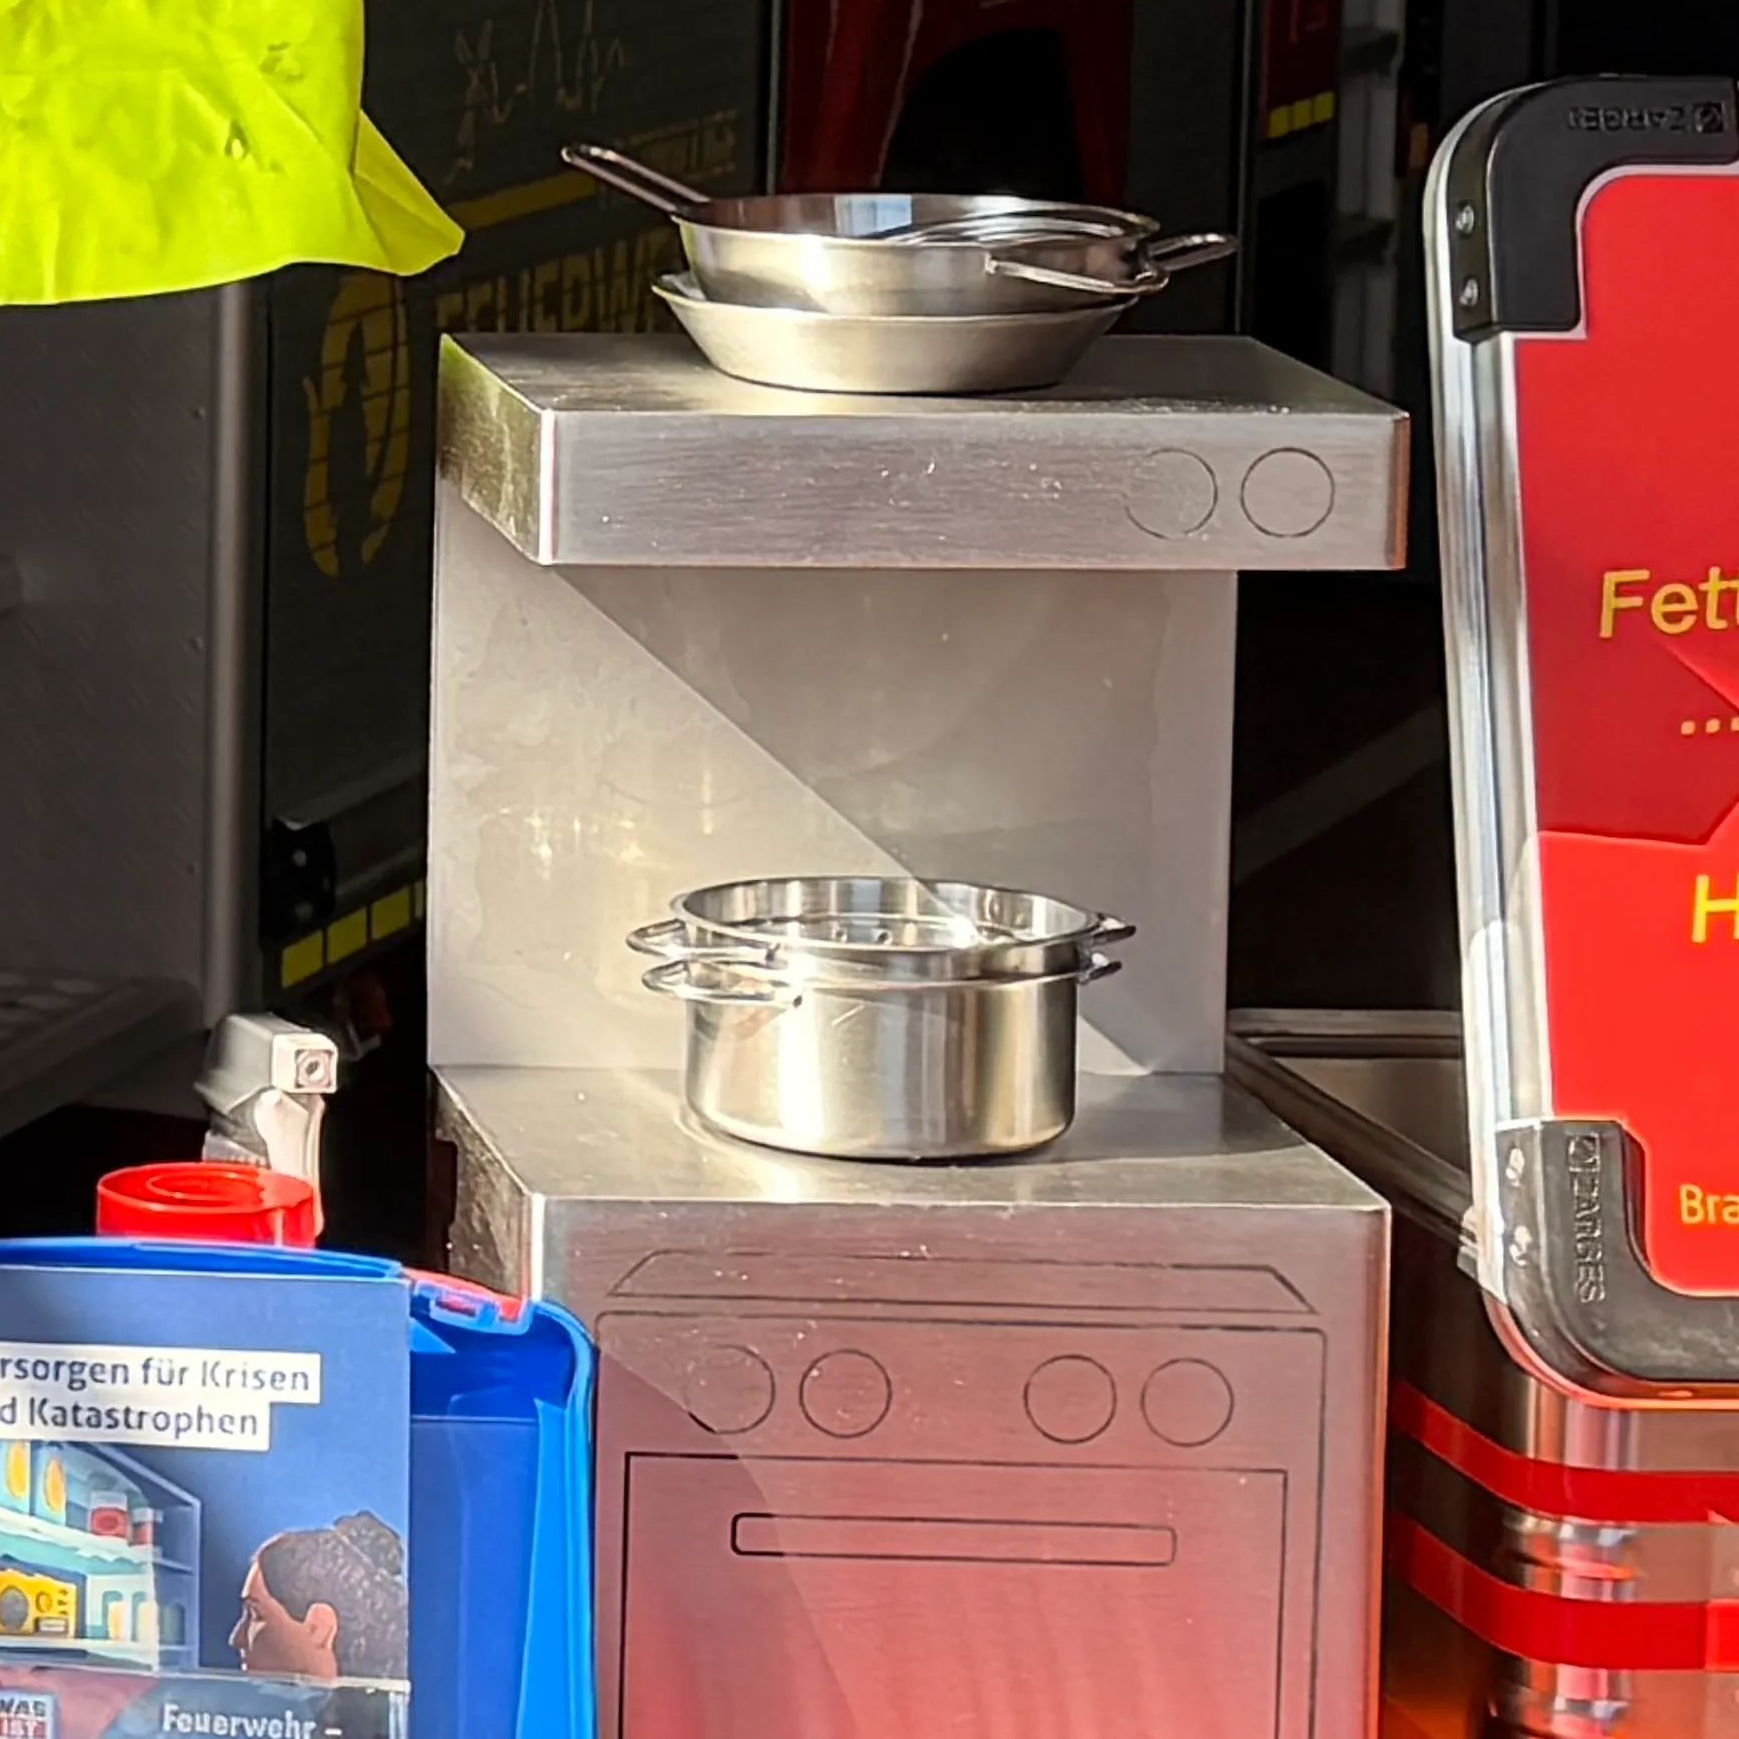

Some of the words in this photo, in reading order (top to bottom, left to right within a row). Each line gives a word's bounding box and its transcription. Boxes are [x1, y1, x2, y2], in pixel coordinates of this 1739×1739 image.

[141, 1356, 189, 1387] für
[201, 1360, 311, 1392] Krisen
[28, 1398, 258, 1439] Katastrophen
[162, 1702, 317, 1739] Feuerwehr
